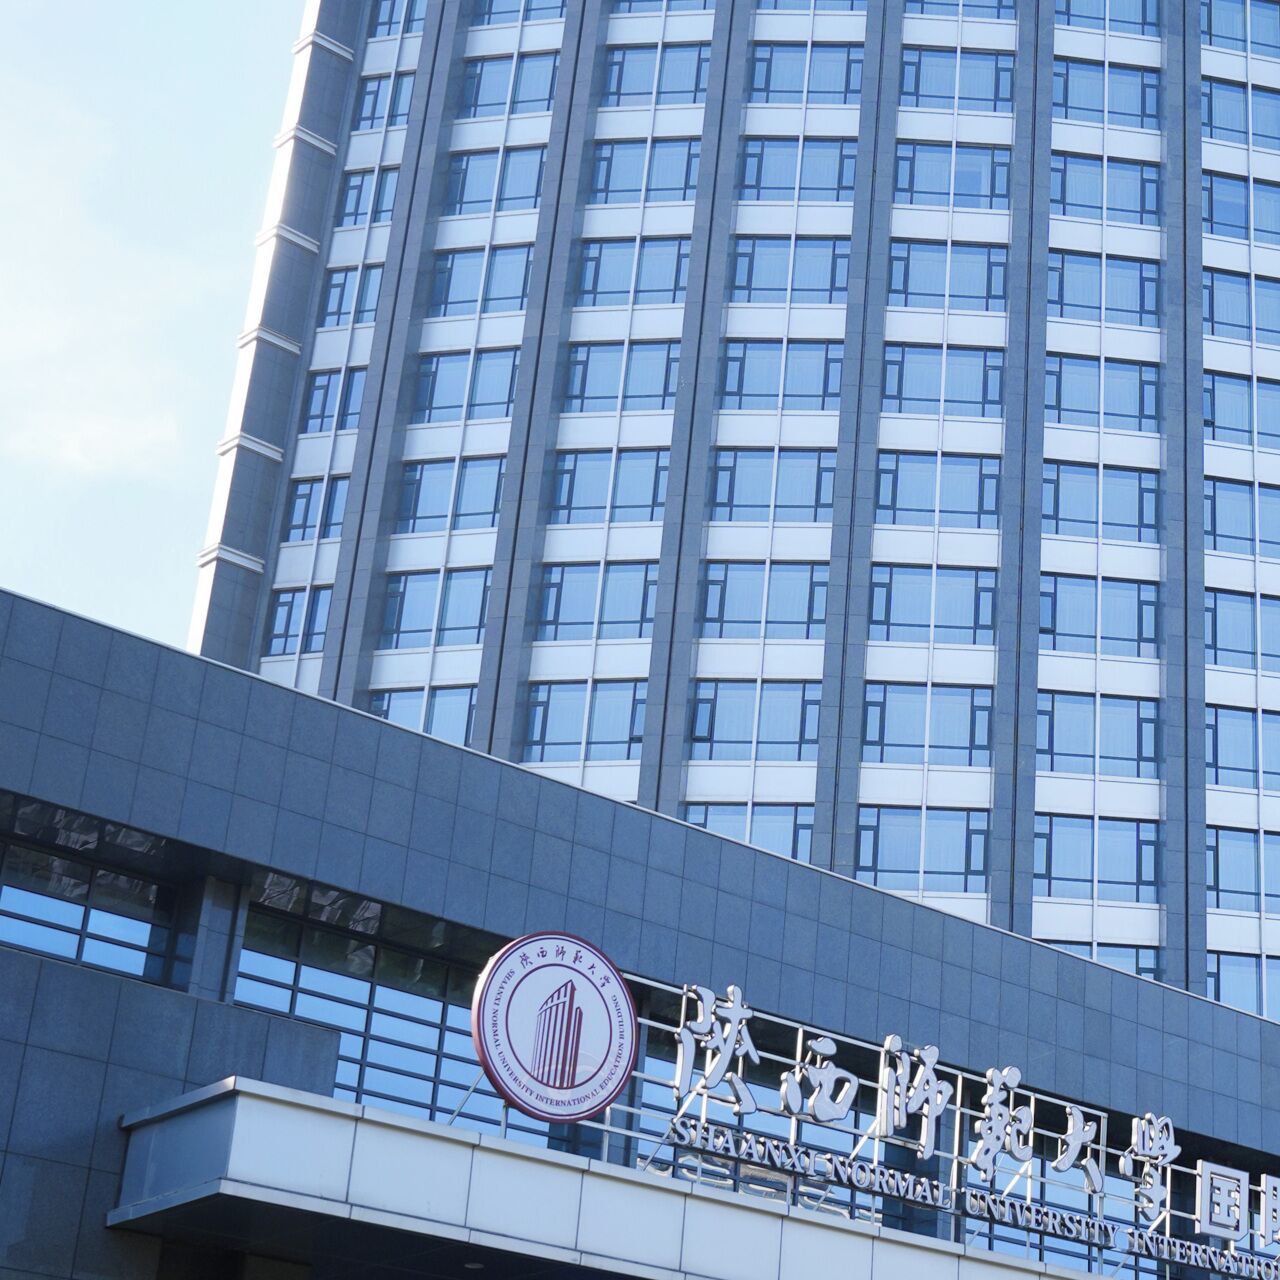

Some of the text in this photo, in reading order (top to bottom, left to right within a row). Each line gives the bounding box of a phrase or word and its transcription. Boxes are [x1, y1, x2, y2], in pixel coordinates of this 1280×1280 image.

[491, 969, 625, 1107] SHAANXI NORMAL UNIVERSITY INTERNATIONAL EDUCATION BUILDING
[673, 1119, 818, 1175] SHAANXI
[825, 1153, 951, 1208] NORMAL
[964, 1188, 1121, 1249] UNIVERSITY
